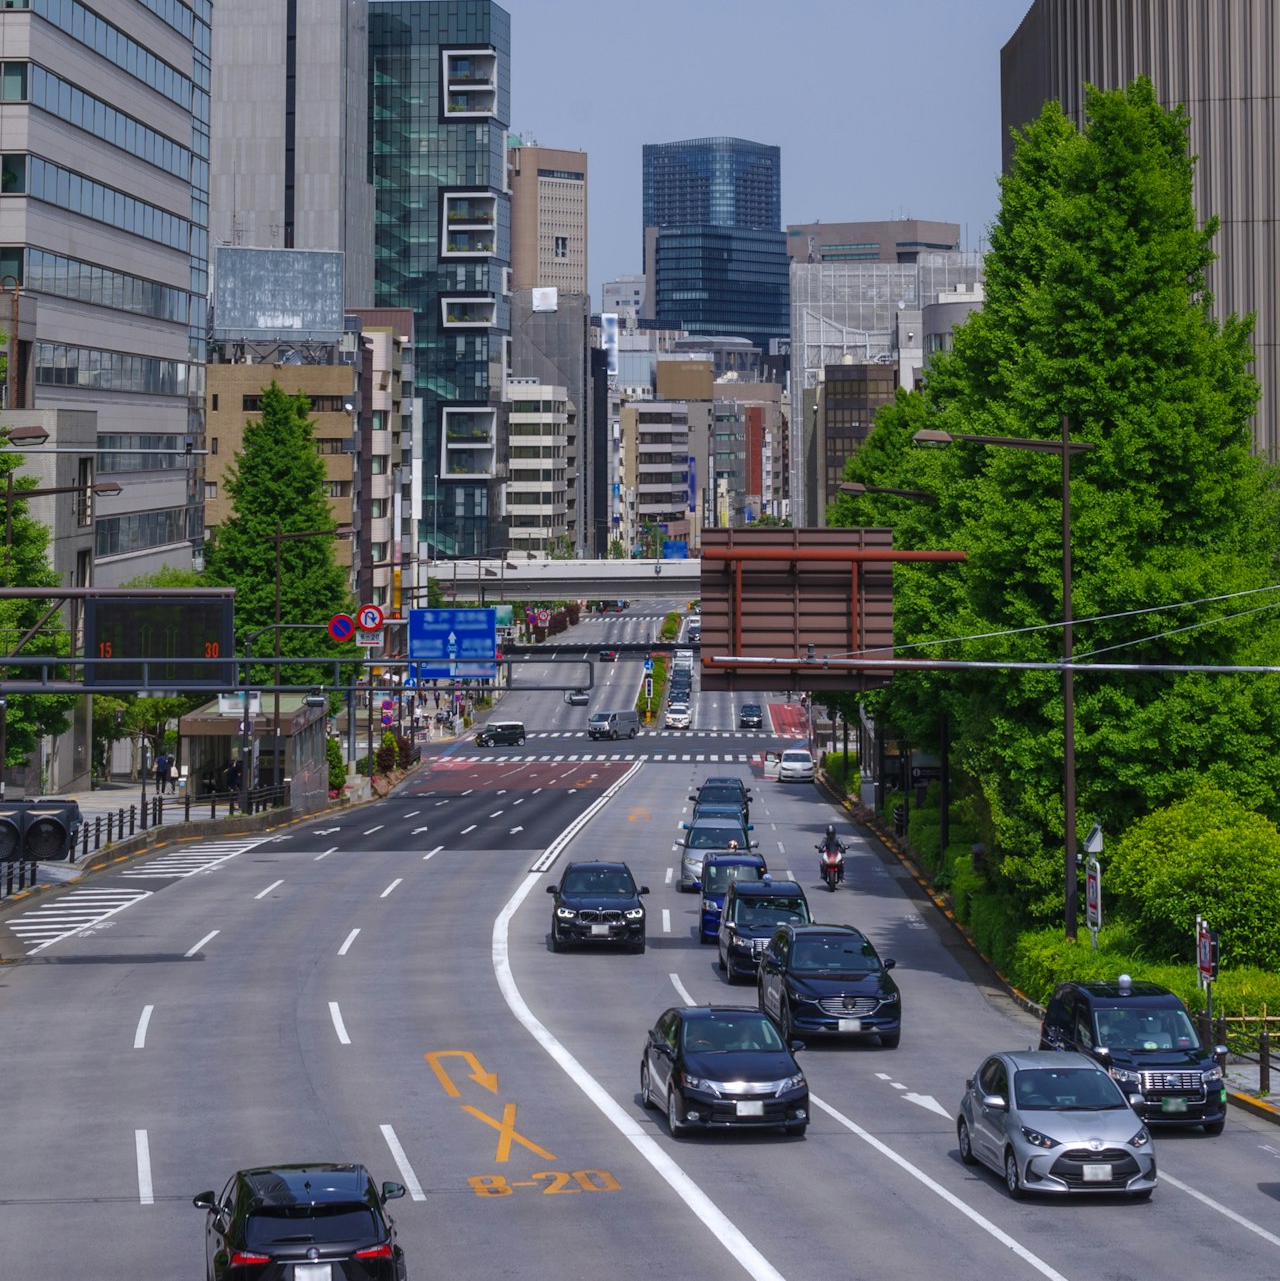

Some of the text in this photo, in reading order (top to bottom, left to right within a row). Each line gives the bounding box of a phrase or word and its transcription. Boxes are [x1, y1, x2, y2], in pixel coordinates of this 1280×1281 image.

[99, 642, 112, 658] 15
[204, 642, 219, 658] 30
[466, 1169, 622, 1197] 8-20
